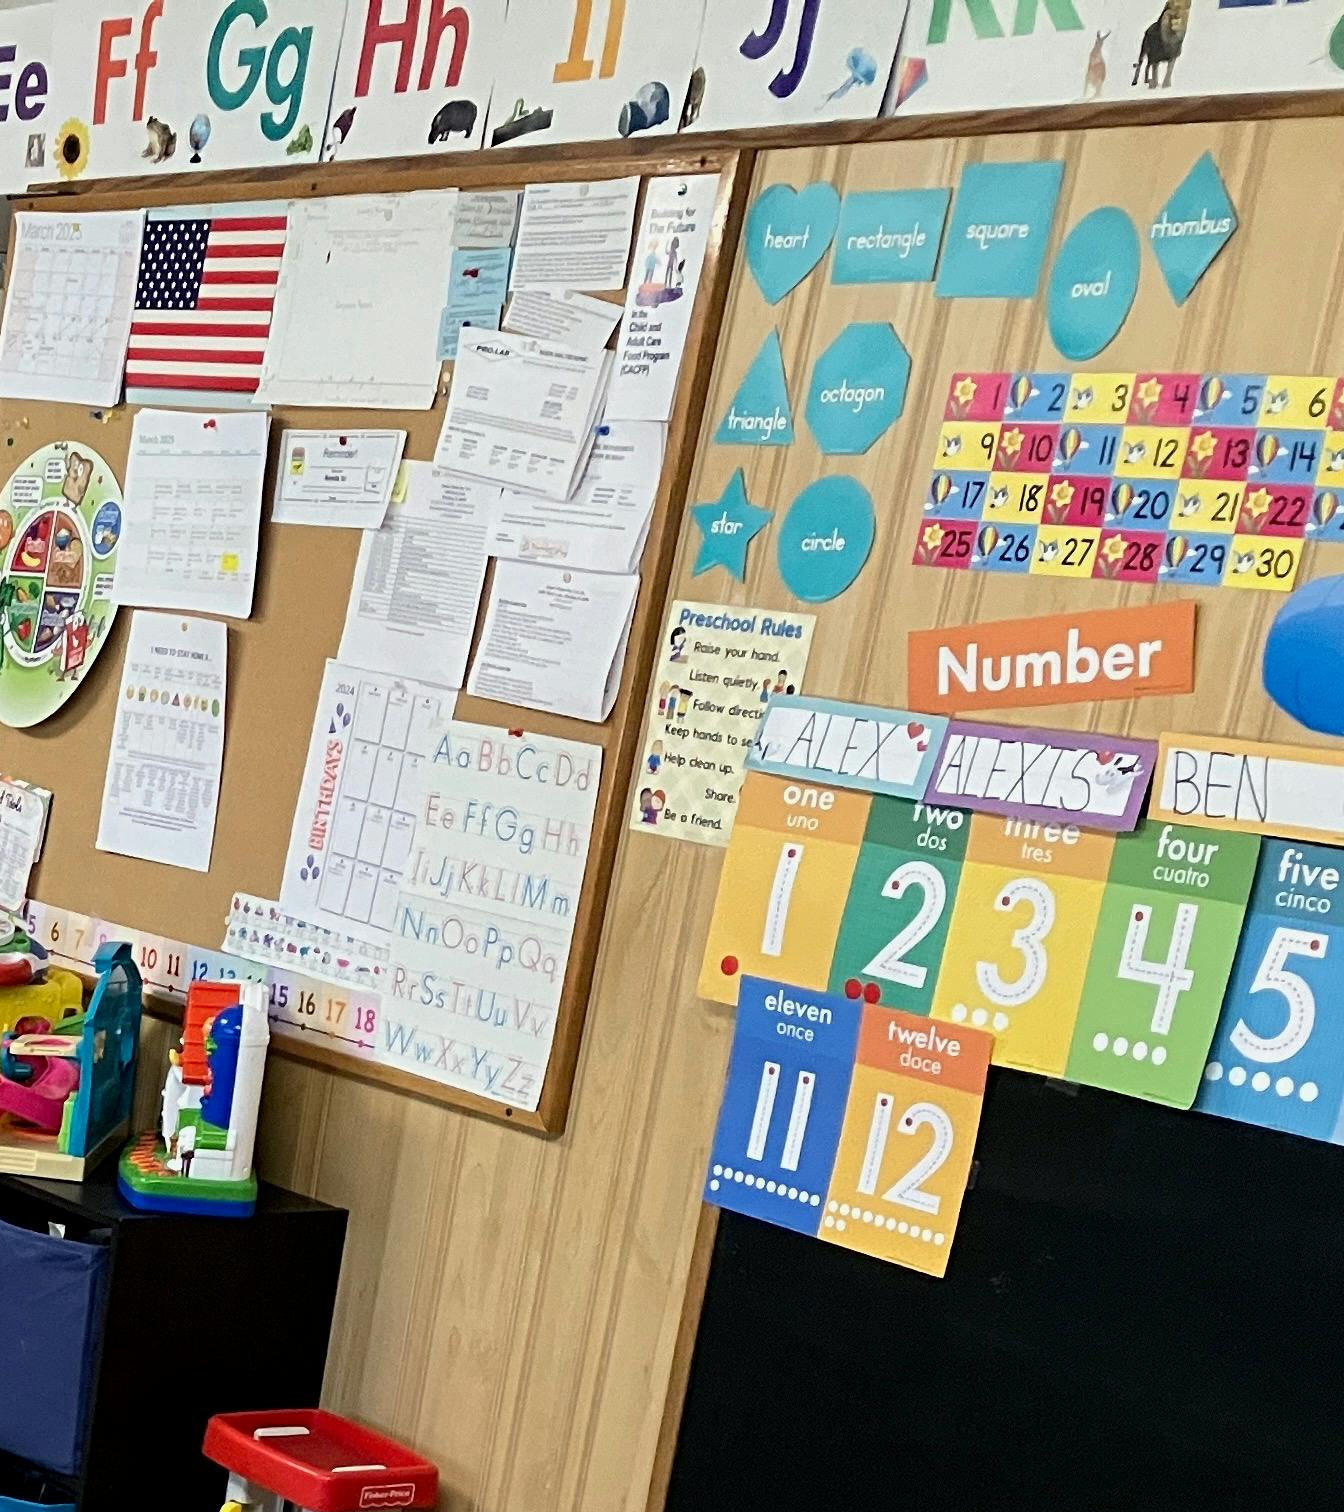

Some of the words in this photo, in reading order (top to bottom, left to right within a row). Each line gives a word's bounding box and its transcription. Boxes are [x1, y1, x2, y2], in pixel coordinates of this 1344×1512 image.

[92, 0, 164, 126] Ff
[207, 0, 314, 141] Gg
[354, 0, 467, 98] Hh
[22, 223, 53, 239] March
[667, 223, 696, 233] Future
[763, 227, 808, 249] heart
[966, 221, 1030, 249] square
[1151, 215, 1230, 238] rhombus
[846, 228, 926, 257] rectangle
[1071, 278, 1110, 298] oval
[646, 337, 661, 346] Care
[820, 383, 885, 408] octagon
[992, 386, 1002, 411] 1
[1048, 384, 1063, 411] 2
[1111, 384, 1128, 412] 3
[1173, 386, 1189, 414] 4
[1241, 386, 1261, 415] 5
[1308, 386, 1326, 417] 6
[727, 409, 787, 433] triangle
[980, 432, 995, 460] 9
[1028, 434, 1053, 463] 10
[1098, 435, 1117, 465] 11
[1152, 438, 1179, 469] 12
[1222, 439, 1250, 468] 13
[1289, 441, 1316, 473] 14
[961, 481, 985, 509] 17
[1018, 484, 1043, 512] 18
[1079, 487, 1106, 516] 19
[1137, 490, 1170, 520] 20
[1211, 492, 1240, 523] 21
[1268, 496, 1306, 527] 22
[710, 516, 744, 534] star
[801, 531, 845, 552] circle
[939, 531, 972, 559] 25
[998, 533, 1030, 563] 26
[1061, 538, 1094, 567] 27
[1123, 542, 1162, 572] 28
[1188, 545, 1225, 576] 29
[1255, 548, 1294, 579] 30
[679, 609, 756, 634] Preschool
[760, 618, 803, 640] Rules
[693, 641, 721, 657] Raise
[724, 648, 747, 662] your
[751, 646, 780, 662] hand.
[938, 628, 1162, 696] Number
[335, 683, 355, 697] 2024
[689, 669, 719, 687] Listen
[722, 673, 760, 691] quietly.
[692, 699, 726, 713] Follow
[664, 723, 691, 740] Keep
[692, 726, 724, 745] hands
[726, 732, 738, 745] to
[741, 736, 754, 748] se
[785, 712, 900, 780] ALEX
[664, 751, 686, 768] Help
[689, 756, 718, 772] clean
[720, 761, 735, 775] up.
[936, 737, 1093, 811] ALEXIS
[309, 739, 344, 851] BIRTHDAYS
[705, 788, 736, 804] Share.
[782, 784, 835, 811] one
[1174, 751, 1270, 821] BEN
[664, 809, 677, 823] Be
[680, 814, 688, 823] a
[691, 812, 723, 830] friend.
[787, 813, 818, 831] uno
[912, 804, 964, 831] two
[917, 828, 947, 851] dos
[1157, 823, 1218, 864] four
[1021, 843, 1053, 864] tres
[1153, 865, 1210, 888] cuatro
[1279, 849, 1340, 890] five
[761, 843, 804, 958] 1
[1275, 888, 1331, 915] cinco
[861, 860, 947, 990] 2
[976, 877, 1056, 1007] 3
[50, 922, 60, 941] 6
[74, 929, 85, 949] 7
[140, 948, 157, 970] 10
[166, 954, 181, 977] 11
[191, 960, 208, 980] 12
[270, 982, 289, 1008] 15
[297, 991, 315, 1015] 16
[325, 999, 346, 1024] 17
[354, 1006, 376, 1033] 18
[1117, 902, 1199, 1036] 4
[764, 991, 833, 1025] eleven
[1229, 927, 1329, 1064] 5
[776, 1021, 815, 1043] once
[888, 1018, 961, 1057] twelve
[899, 1050, 942, 1075] doce
[746, 1061, 816, 1172] 11
[856, 1092, 954, 1215] 12
[364, 1490, 410, 1500] Fisher-Price
